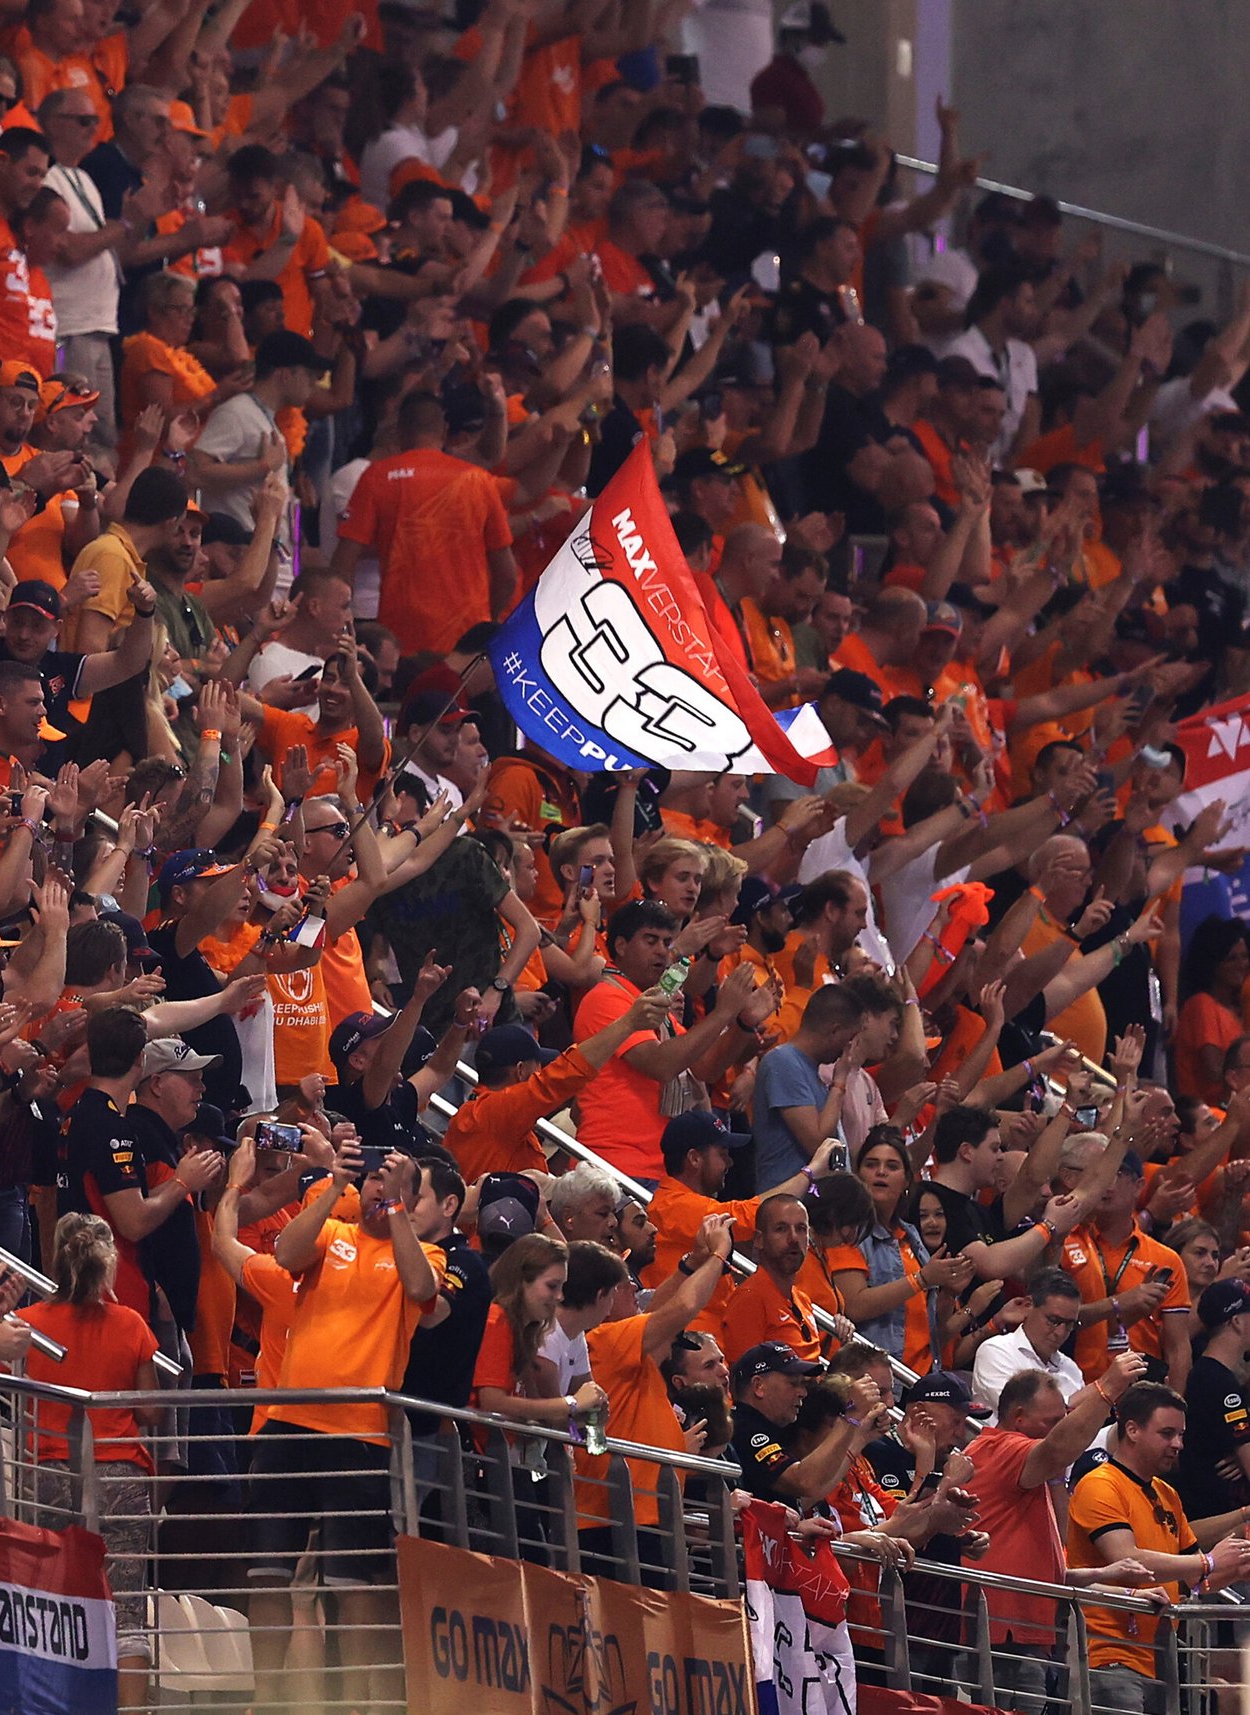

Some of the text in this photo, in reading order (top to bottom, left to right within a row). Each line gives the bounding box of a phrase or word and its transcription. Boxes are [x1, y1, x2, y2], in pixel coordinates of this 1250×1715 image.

[611, 508, 657, 580] MAX
[330, 1239, 357, 1263] 33
[930, 1390, 951, 1398] exact
[431, 1606, 469, 1683] GO
[646, 1651, 680, 1715] GO
